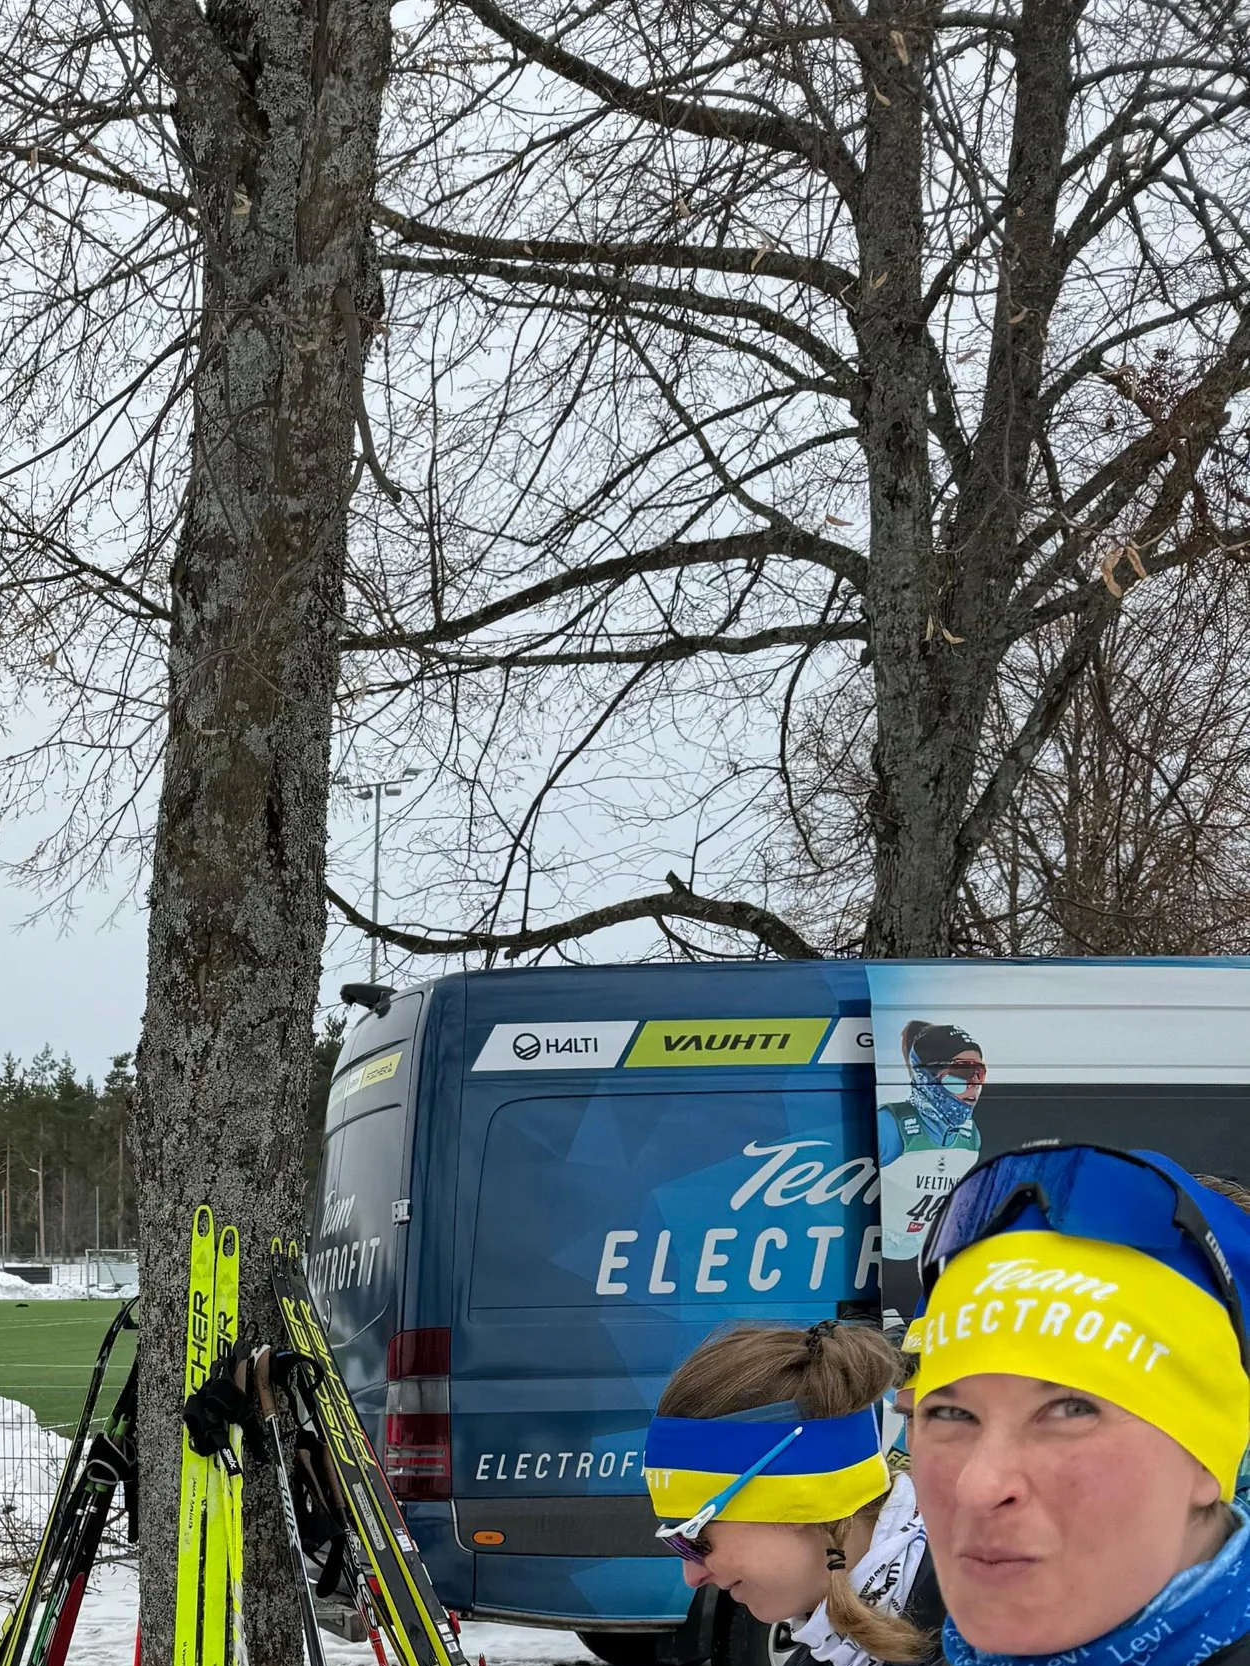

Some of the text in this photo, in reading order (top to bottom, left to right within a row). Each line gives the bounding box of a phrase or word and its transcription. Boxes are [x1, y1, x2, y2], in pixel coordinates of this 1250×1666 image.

[546, 1037, 599, 1054] HALTI
[663, 1033, 791, 1052] VAUHTI
[595, 1225, 882, 1295] ELECTR
[973, 1258, 1118, 1300] Team
[924, 1298, 1171, 1372] ELECTROFIT
[299, 1299, 377, 1467] FISCHER
[476, 1451, 646, 1481] ELECTROF
[1106, 1616, 1175, 1664] Levi
